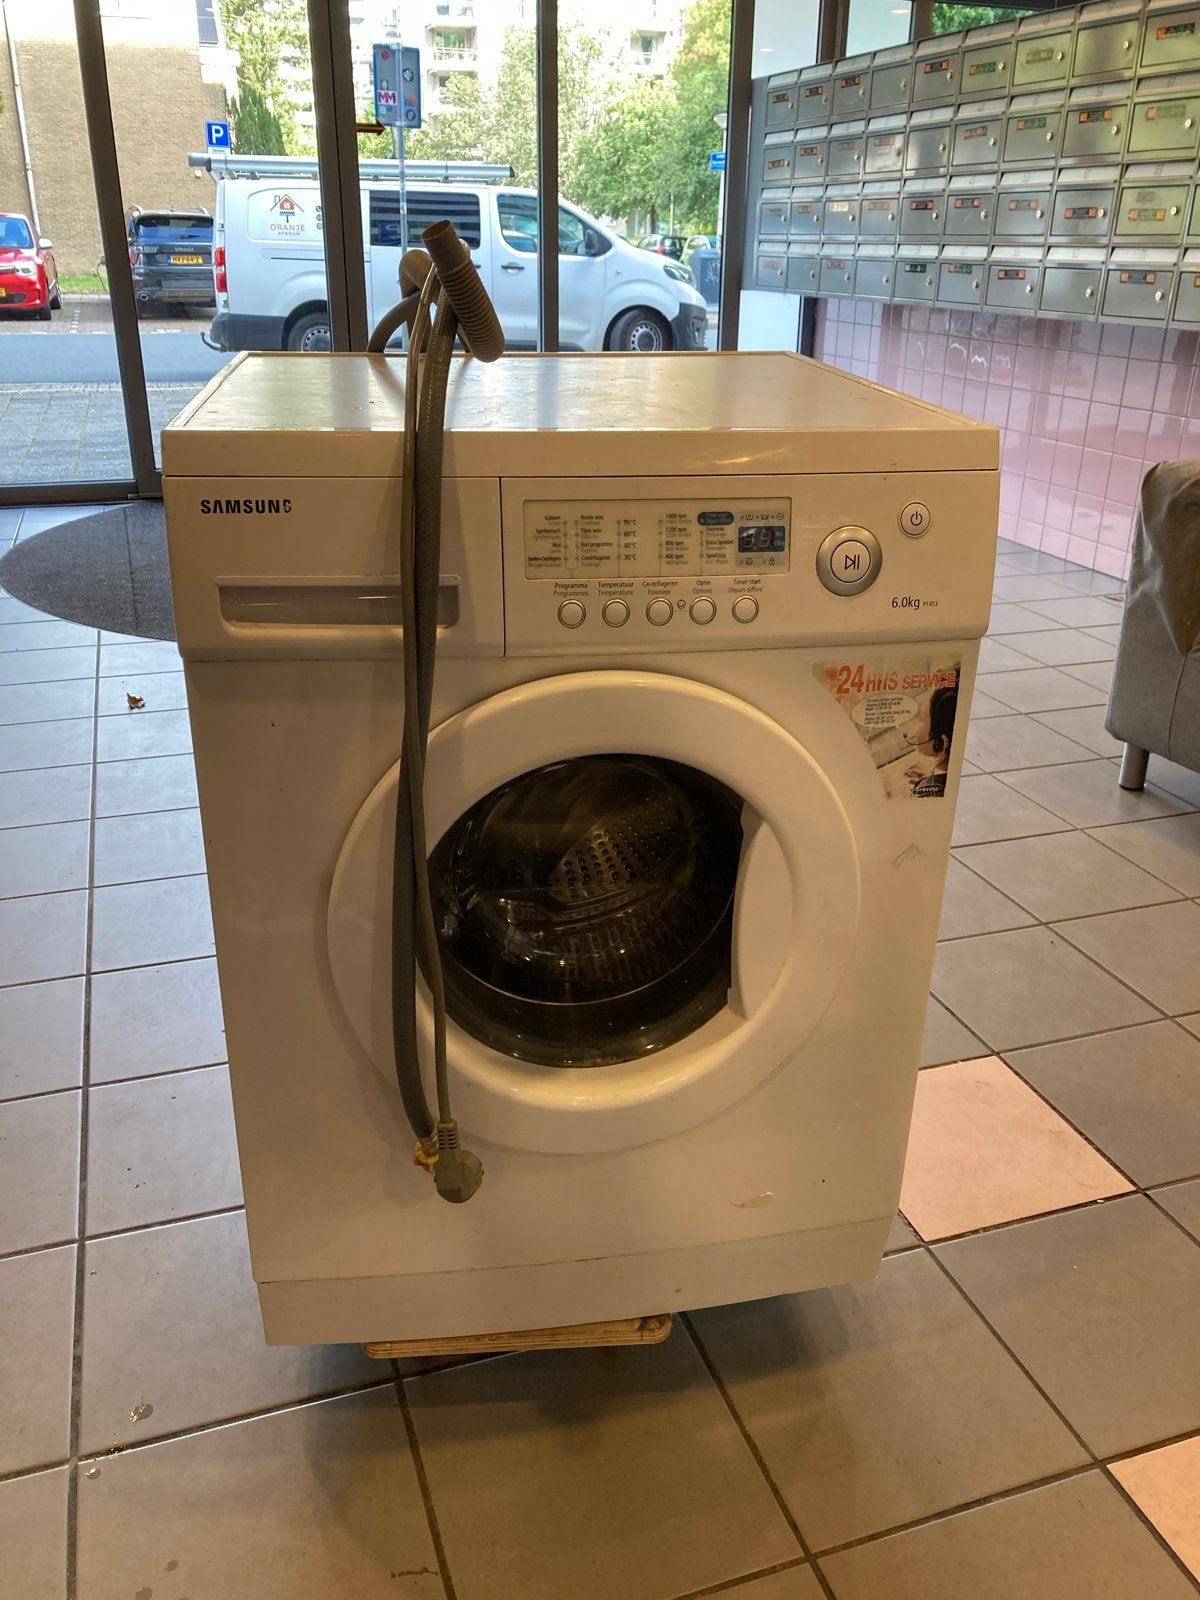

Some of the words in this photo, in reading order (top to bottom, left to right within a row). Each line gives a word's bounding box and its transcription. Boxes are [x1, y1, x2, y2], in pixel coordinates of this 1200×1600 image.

[212, 125, 224, 144] P
[270, 224, 306, 232] ORANJE
[554, 582, 588, 591] Programma
[598, 581, 634, 589] Temperatuur
[642, 580, 678, 588] Centrifugeren
[697, 579, 711, 587] Optie
[553, 590, 589, 598] Programmes
[647, 588, 671, 596] Essorage
[892, 596, 920, 611] 6.0kg
[836, 664, 865, 695] 24
[902, 671, 957, 691] SERVICE
